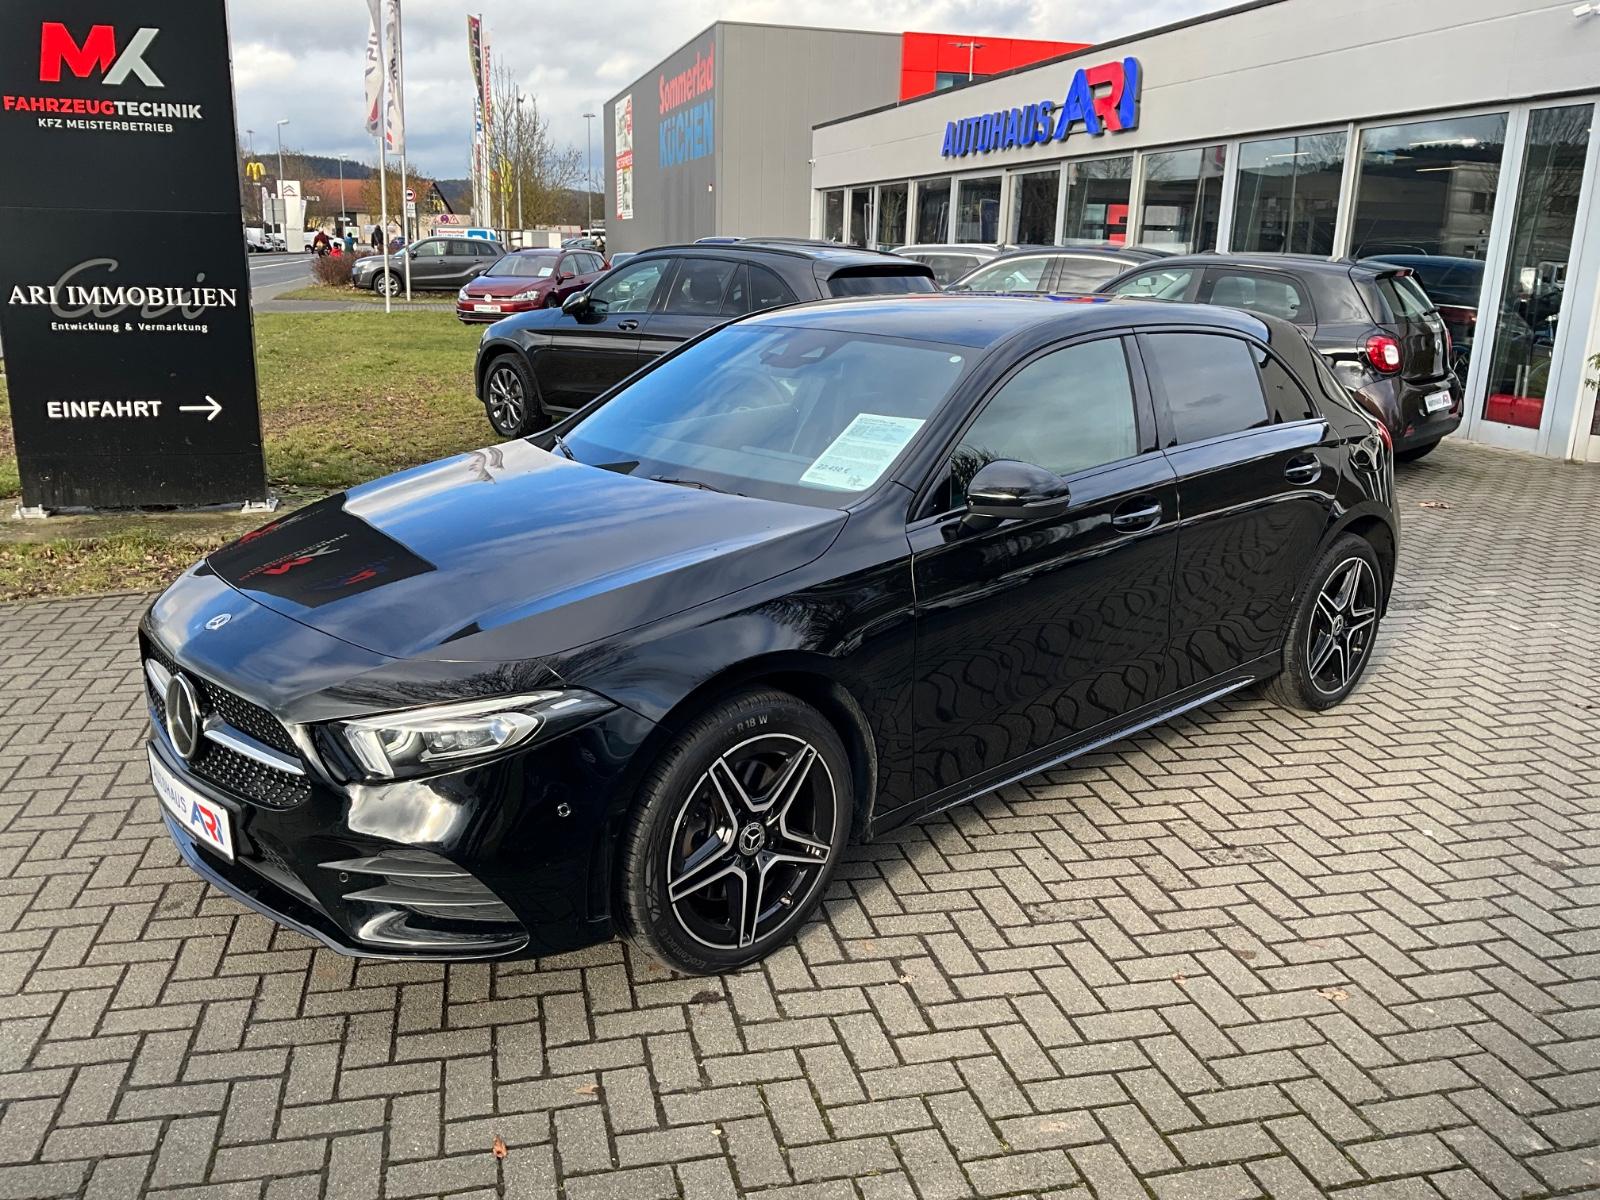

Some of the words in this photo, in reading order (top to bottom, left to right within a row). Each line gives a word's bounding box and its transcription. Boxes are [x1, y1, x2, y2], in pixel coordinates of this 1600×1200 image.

[39, 21, 165, 88] MK
[658, 43, 716, 115] Sommerlad
[3, 95, 203, 119] FAHRZEUGTECHNIK
[941, 100, 1054, 158] AUTOHAUS
[1053, 56, 1143, 141] ARI
[38, 118, 63, 129] KFZ
[66, 119, 174, 133] MEISTERBETRIEB
[8, 284, 58, 305] ARI
[67, 285, 238, 307] IMMOBILIEN
[51, 321, 120, 332] Entwicklung
[125, 322, 133, 331] &
[137, 322, 208, 333] Vermarktung
[47, 400, 162, 418] EINFAHRT
[191, 800, 225, 846] ARI
